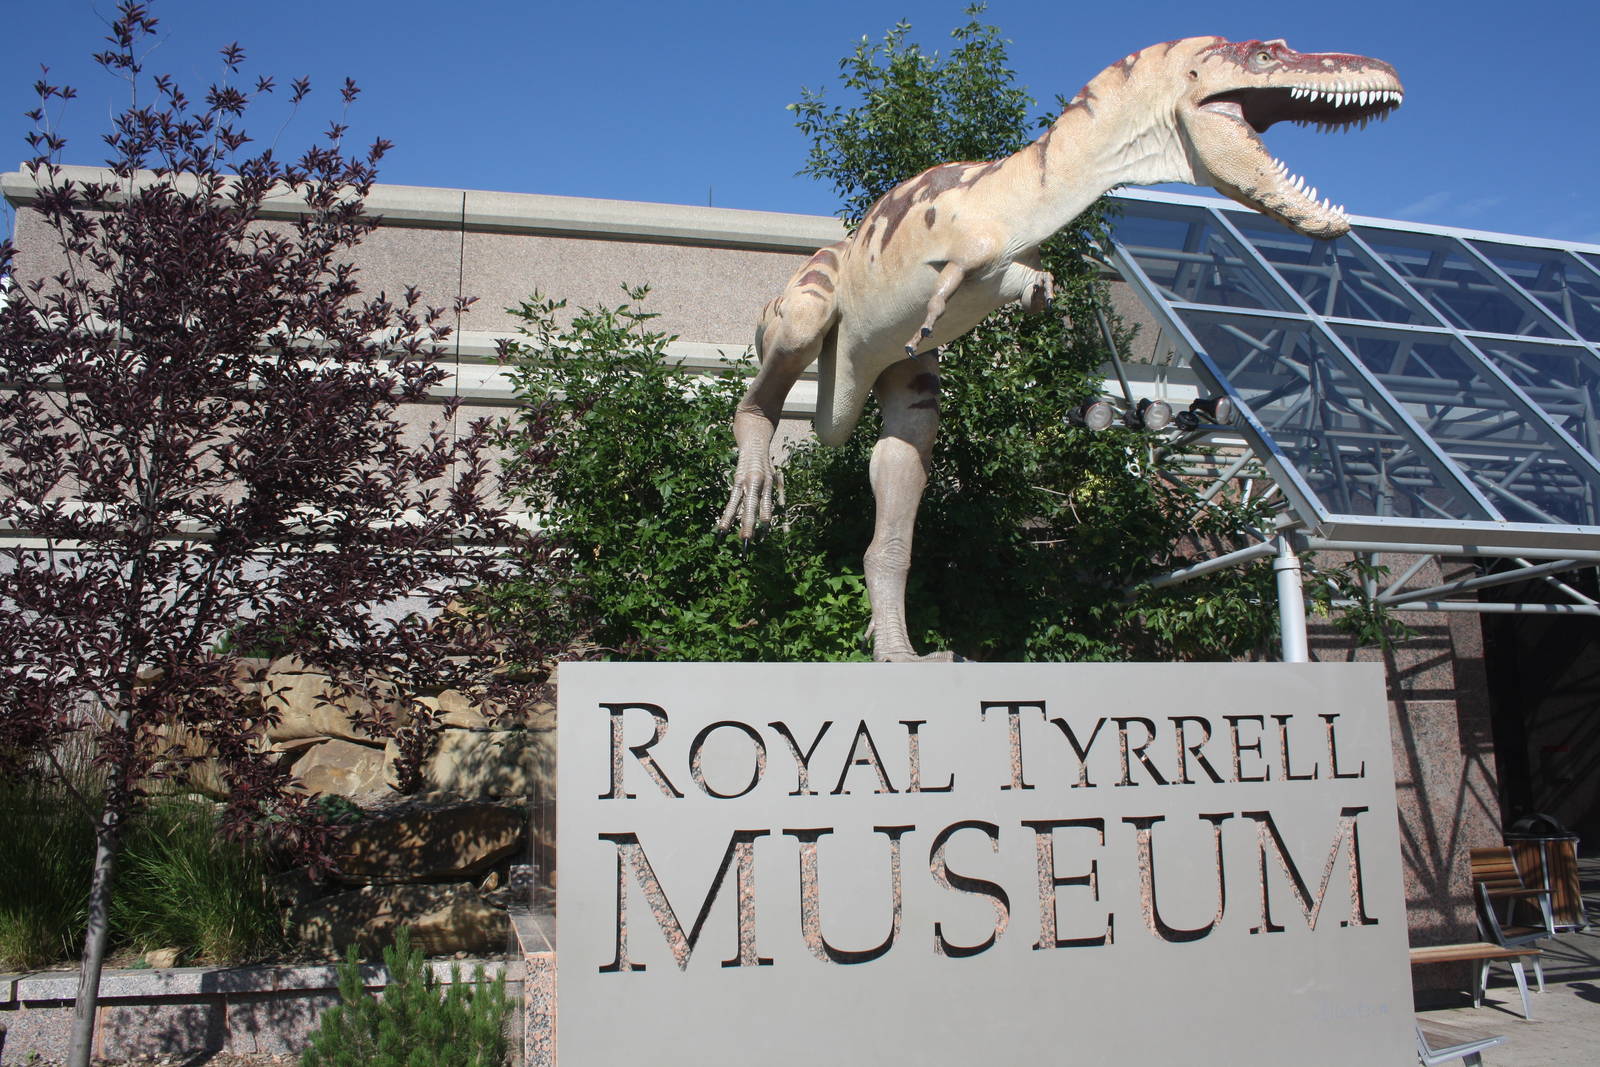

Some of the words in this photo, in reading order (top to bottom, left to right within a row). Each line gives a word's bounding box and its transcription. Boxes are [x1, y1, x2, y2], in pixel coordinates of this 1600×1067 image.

[598, 702, 955, 799] ROYAL
[980, 700, 1365, 790] TYRRELL
[598, 806, 1379, 973] MUSEUM
